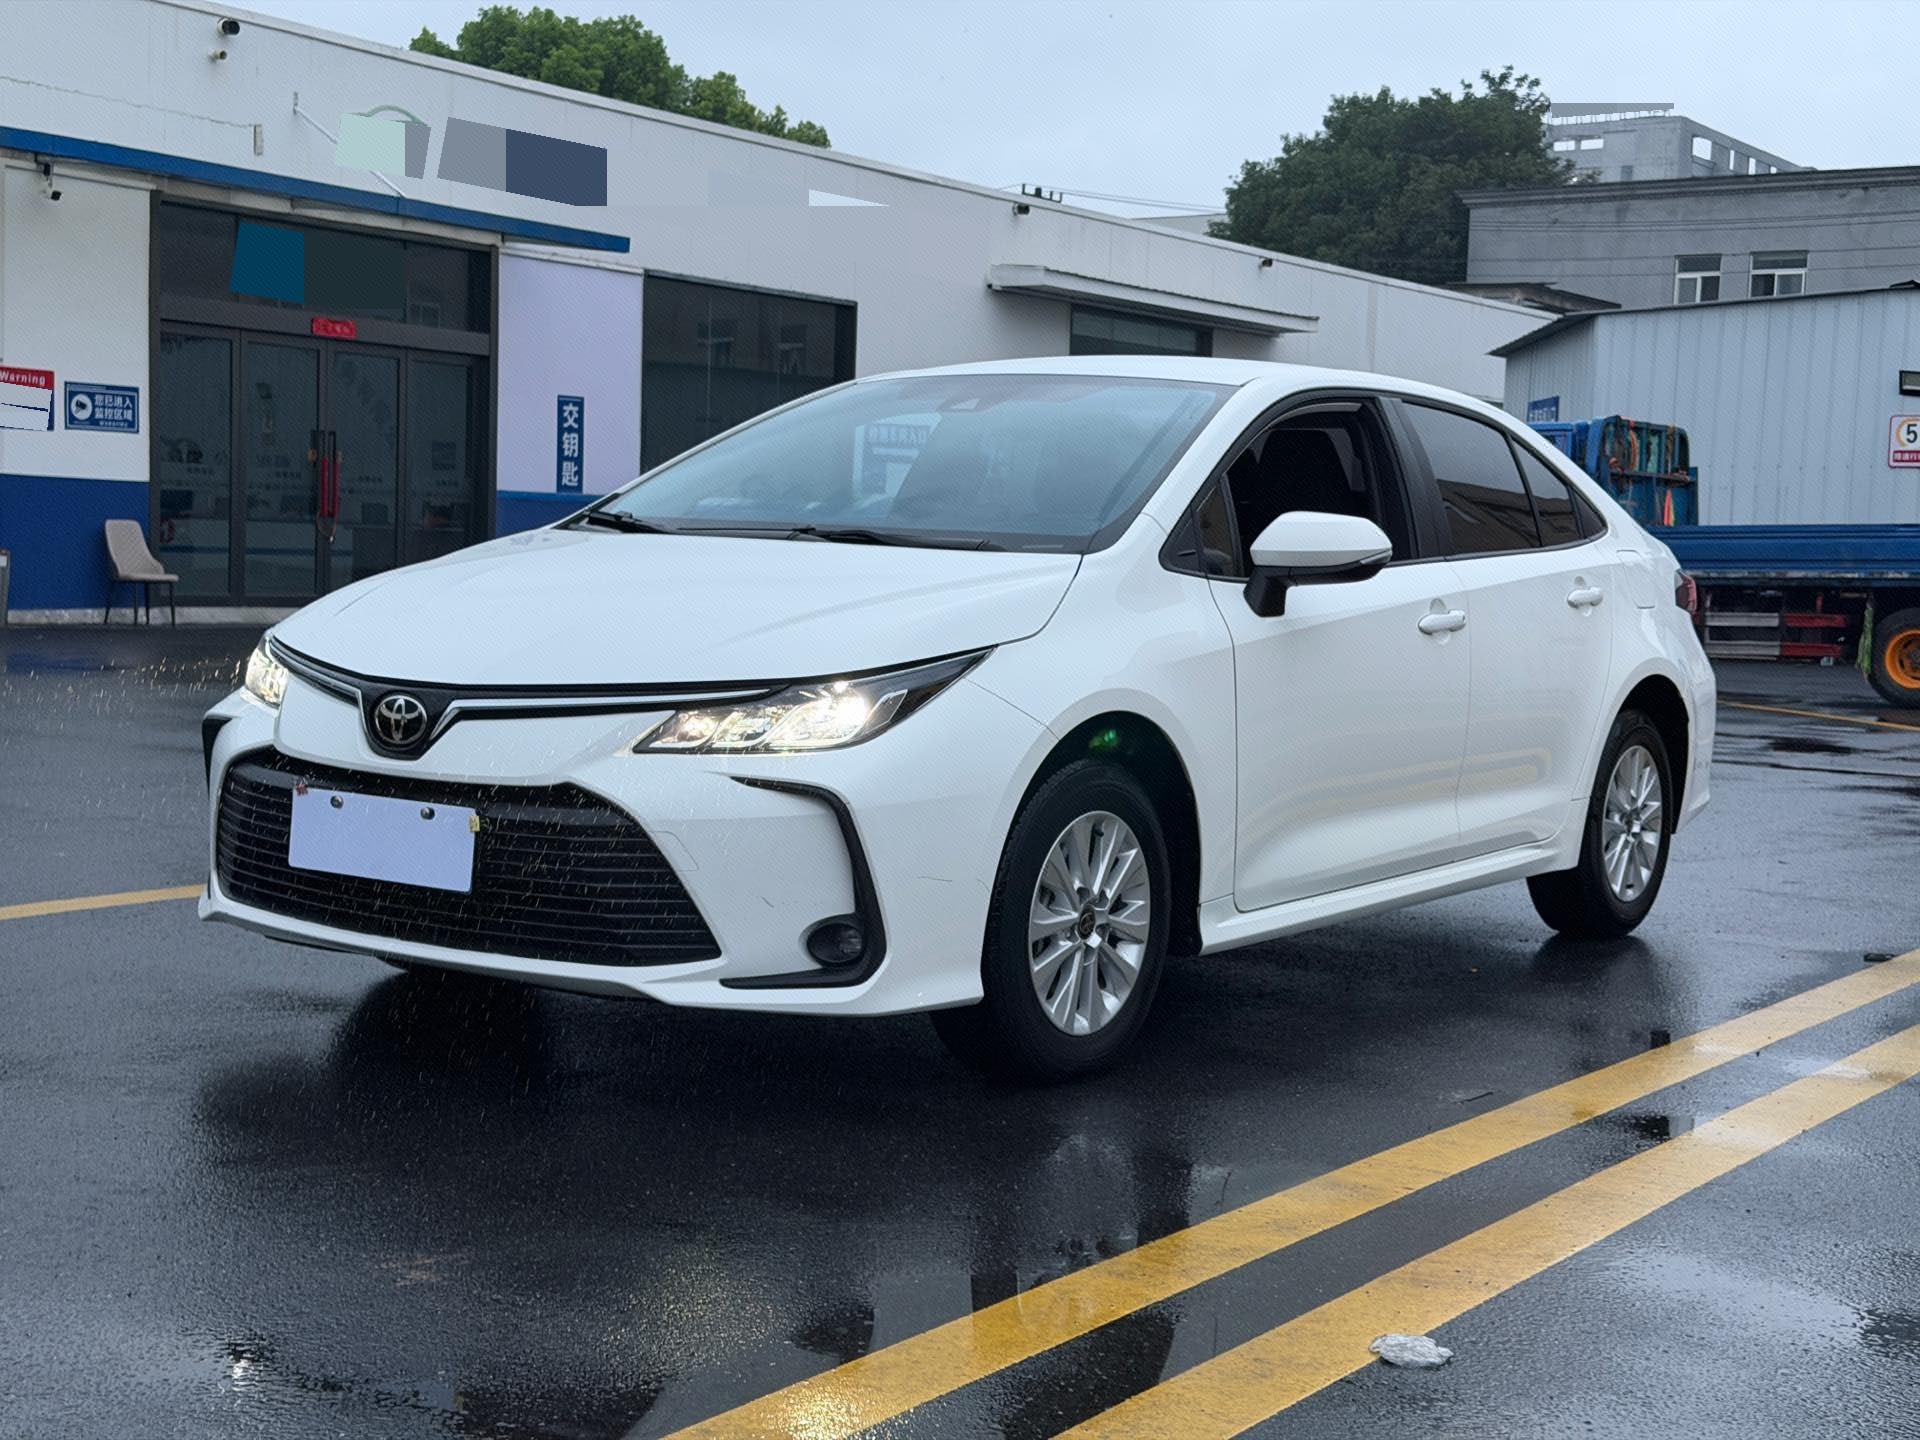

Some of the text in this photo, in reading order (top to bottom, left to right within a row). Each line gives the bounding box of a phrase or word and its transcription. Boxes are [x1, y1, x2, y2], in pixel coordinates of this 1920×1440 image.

[0, 369, 46, 387] Warning
[562, 402, 579, 486] 交钥匙
[1906, 423, 1918, 444] 5
